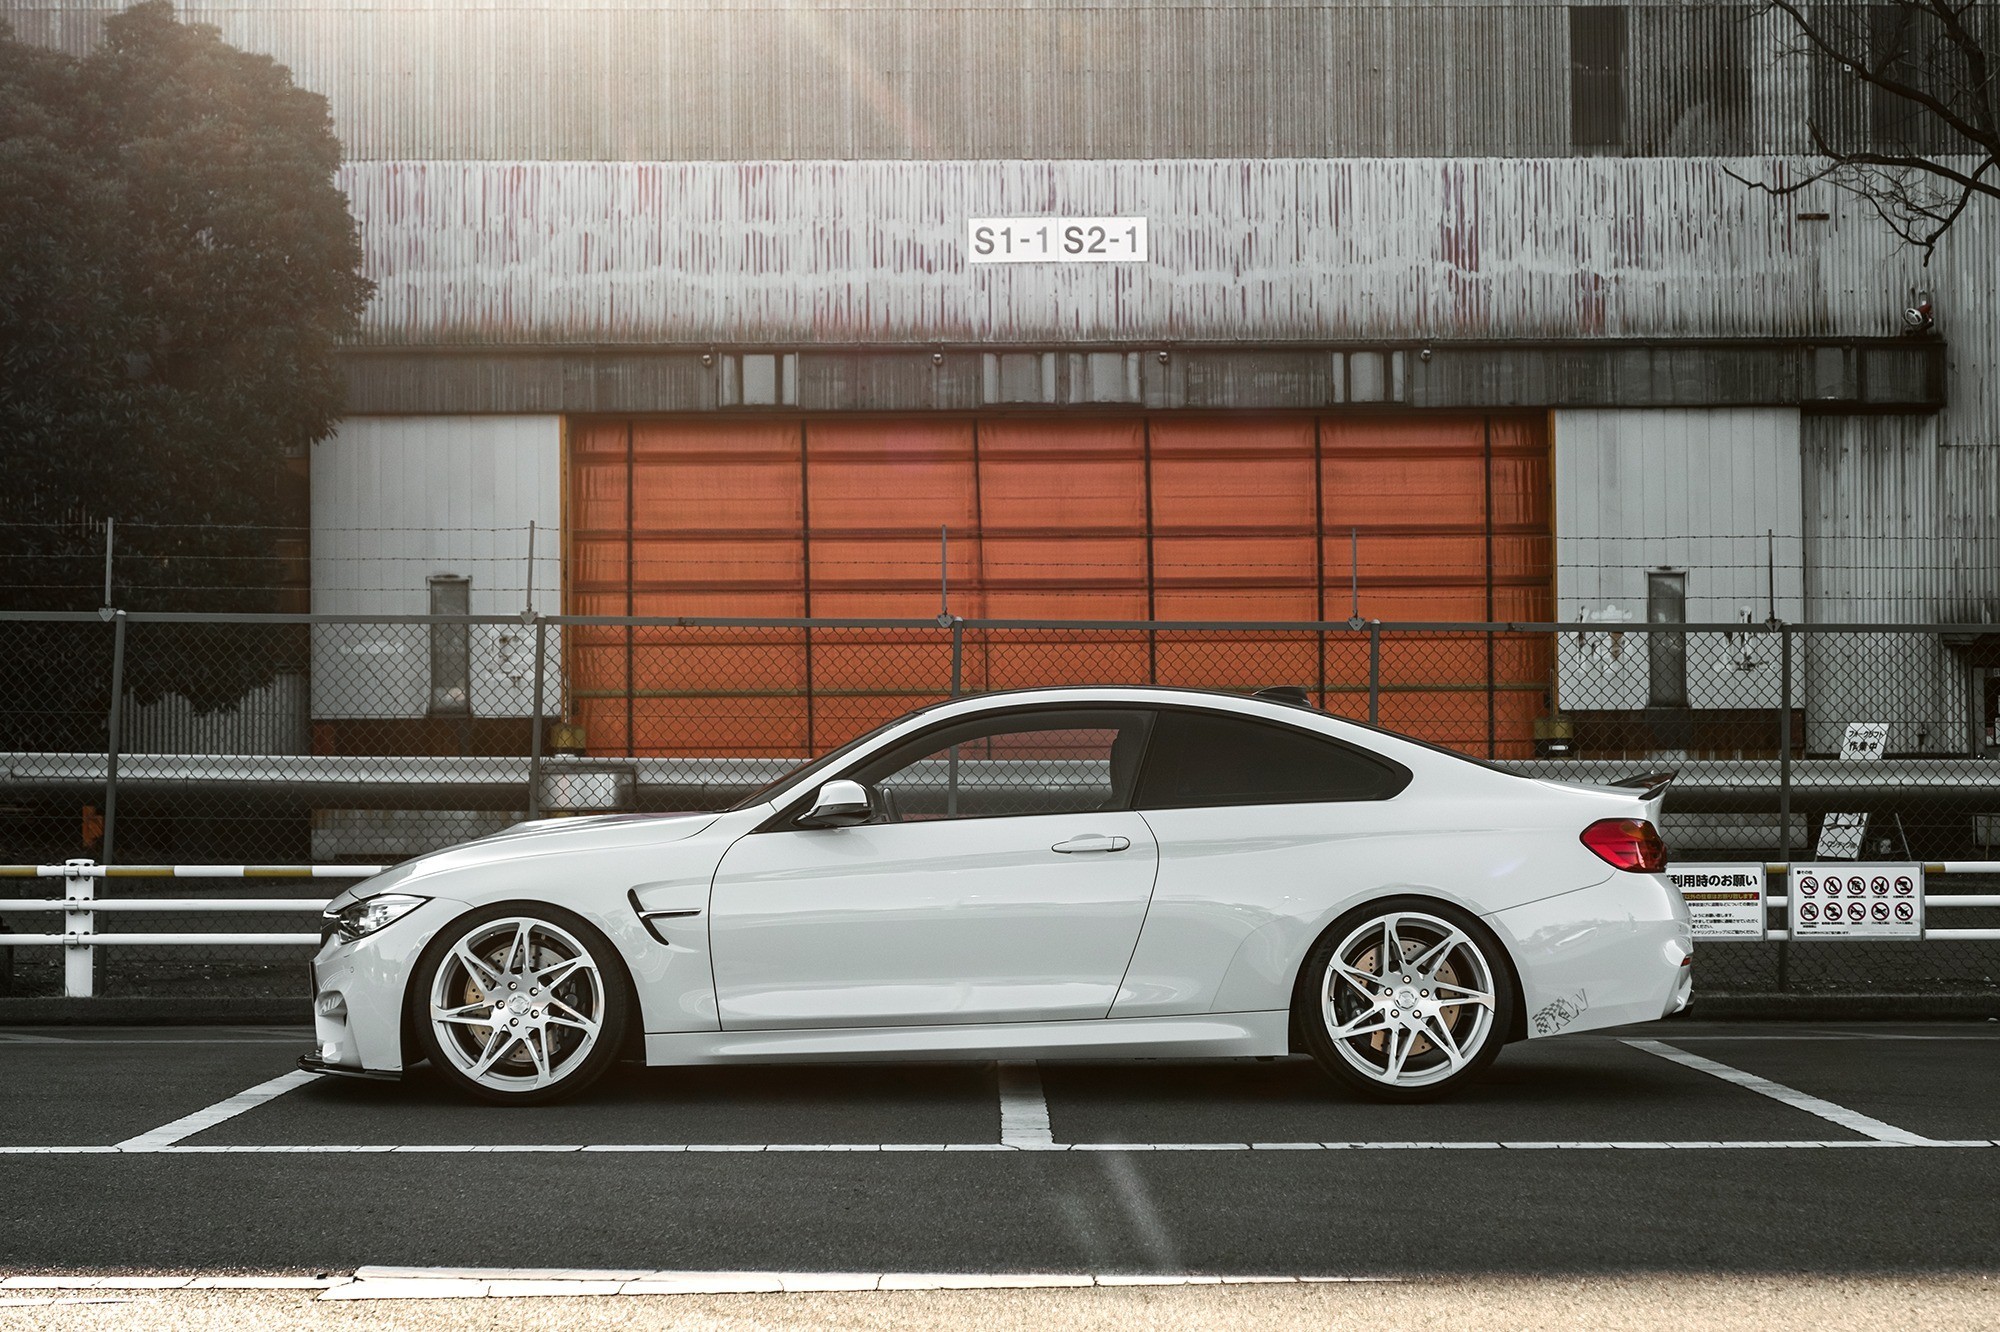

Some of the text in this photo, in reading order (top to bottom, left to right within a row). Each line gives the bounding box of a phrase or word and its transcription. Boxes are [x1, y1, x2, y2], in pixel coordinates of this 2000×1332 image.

[974, 225, 1137, 255] S1-1 S2-1
[1667, 874, 1758, 888] 利用時のお願い
[1544, 988, 1589, 1034] KW
